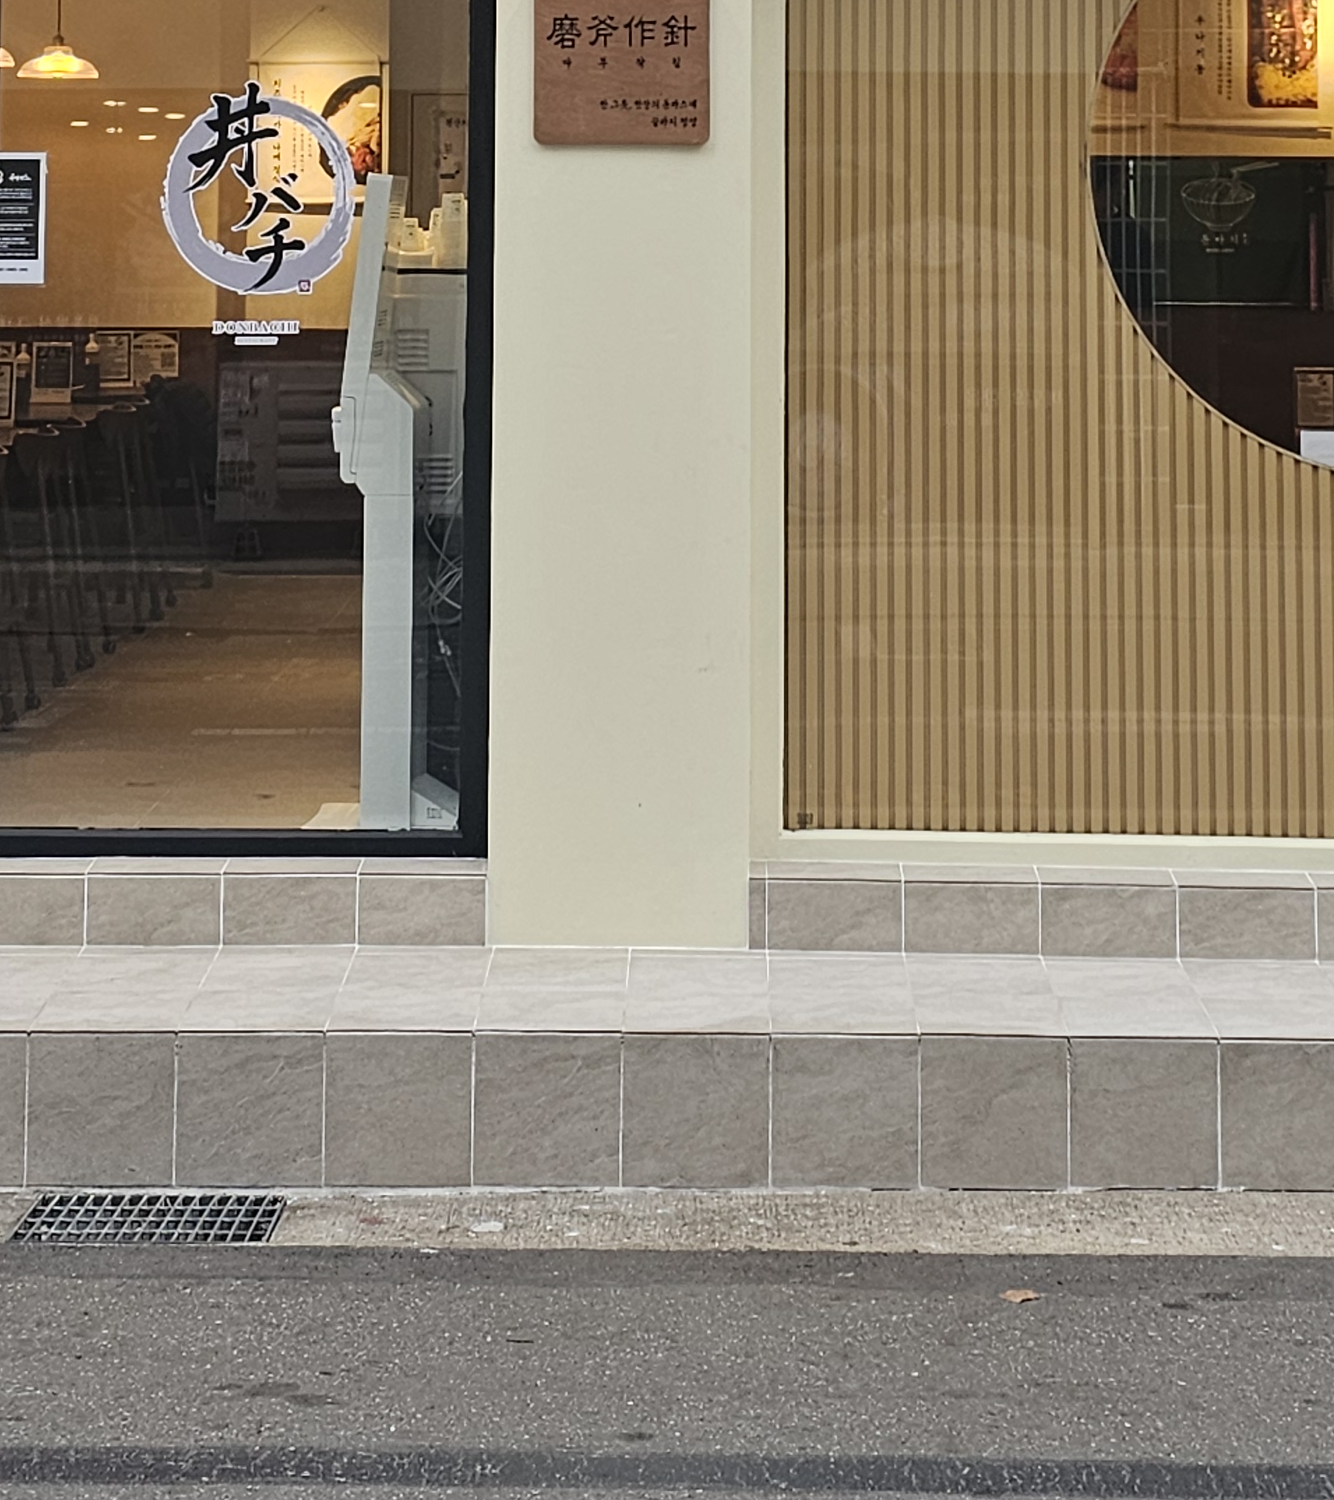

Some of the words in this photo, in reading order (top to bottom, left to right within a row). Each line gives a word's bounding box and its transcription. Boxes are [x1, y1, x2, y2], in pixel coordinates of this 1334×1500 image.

[546, 13, 697, 49] 磨斧作針
[183, 82, 305, 292] 丼バチ
[213, 321, 298, 333] DONBACHI
